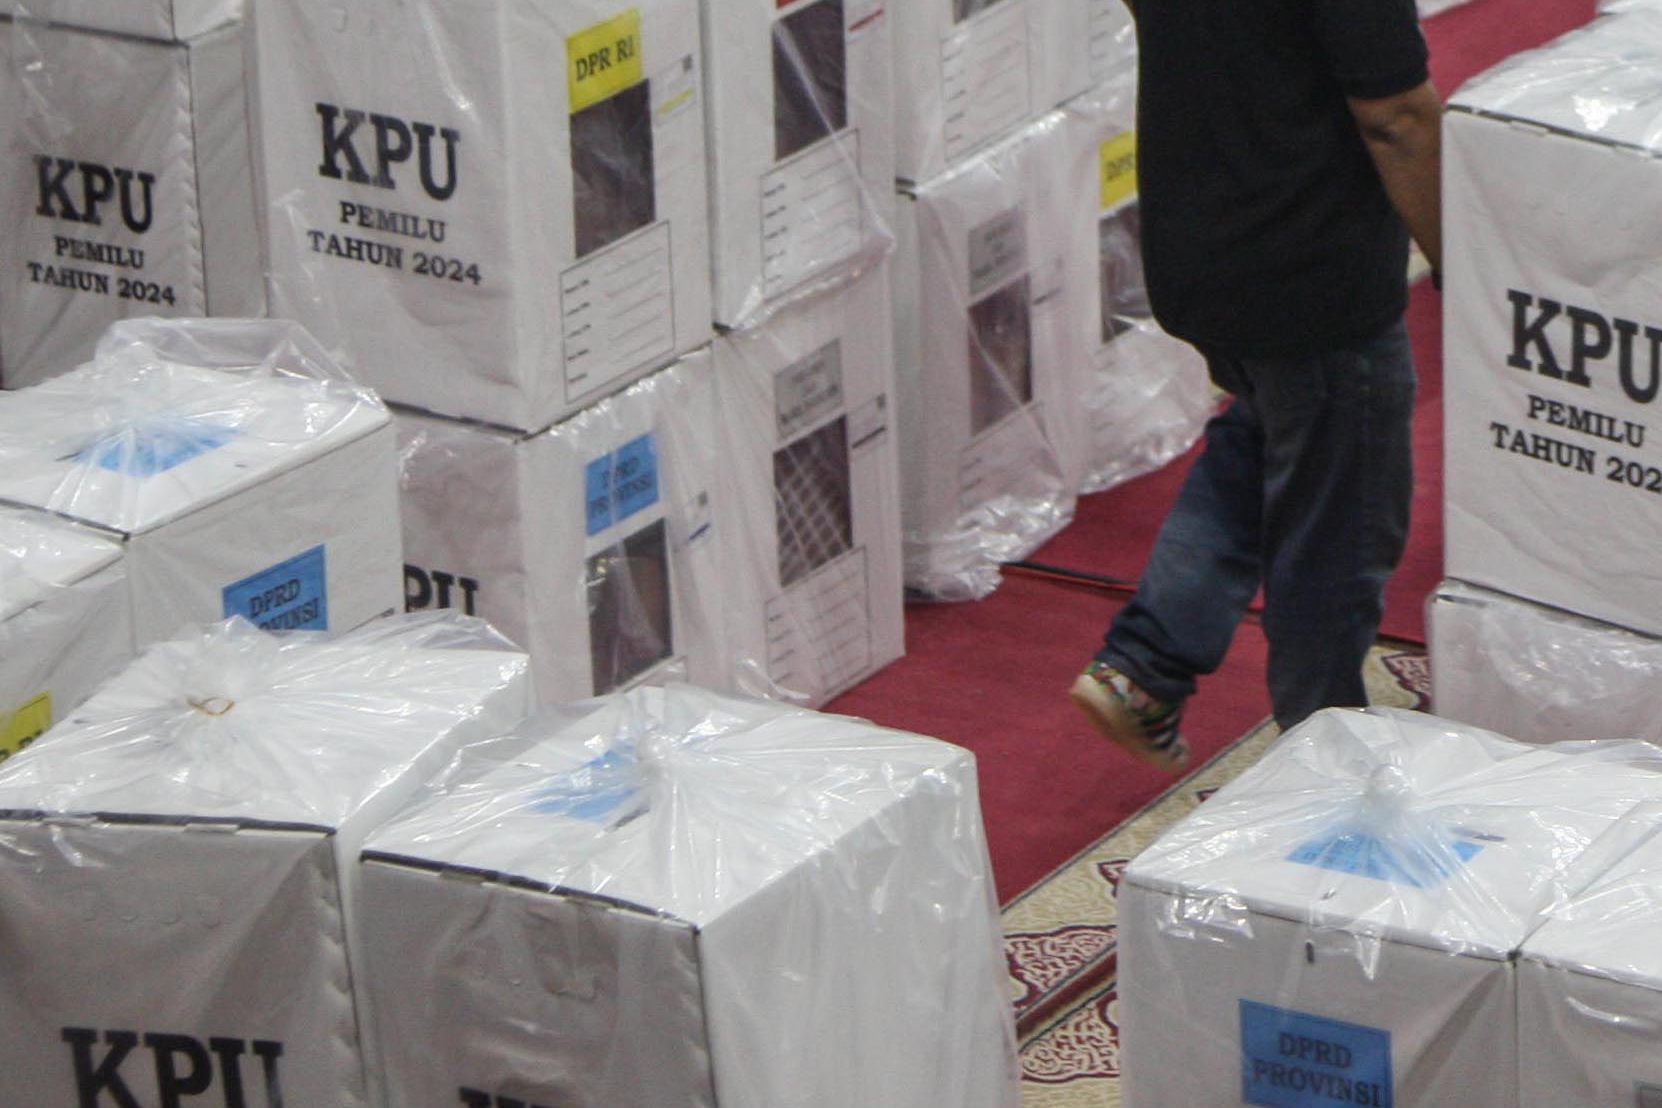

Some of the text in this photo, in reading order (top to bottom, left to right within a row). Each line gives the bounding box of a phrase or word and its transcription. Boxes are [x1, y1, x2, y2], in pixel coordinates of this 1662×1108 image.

[575, 35, 634, 81] DPR RI
[315, 103, 461, 201] KPU
[33, 154, 156, 235] KPU
[340, 200, 446, 242] PEMILU
[55, 236, 144, 269] PEMILU
[308, 230, 482, 286] TAHUN 2024
[27, 262, 176, 306] TAHUN 2024
[1527, 395, 1646, 447] PEMILU
[1491, 422, 1595, 475] TAHUN
[251, 577, 300, 620] DPRD
[1277, 1031, 1351, 1068] DPRD
[1252, 1059, 1381, 1108] PROVINSI
